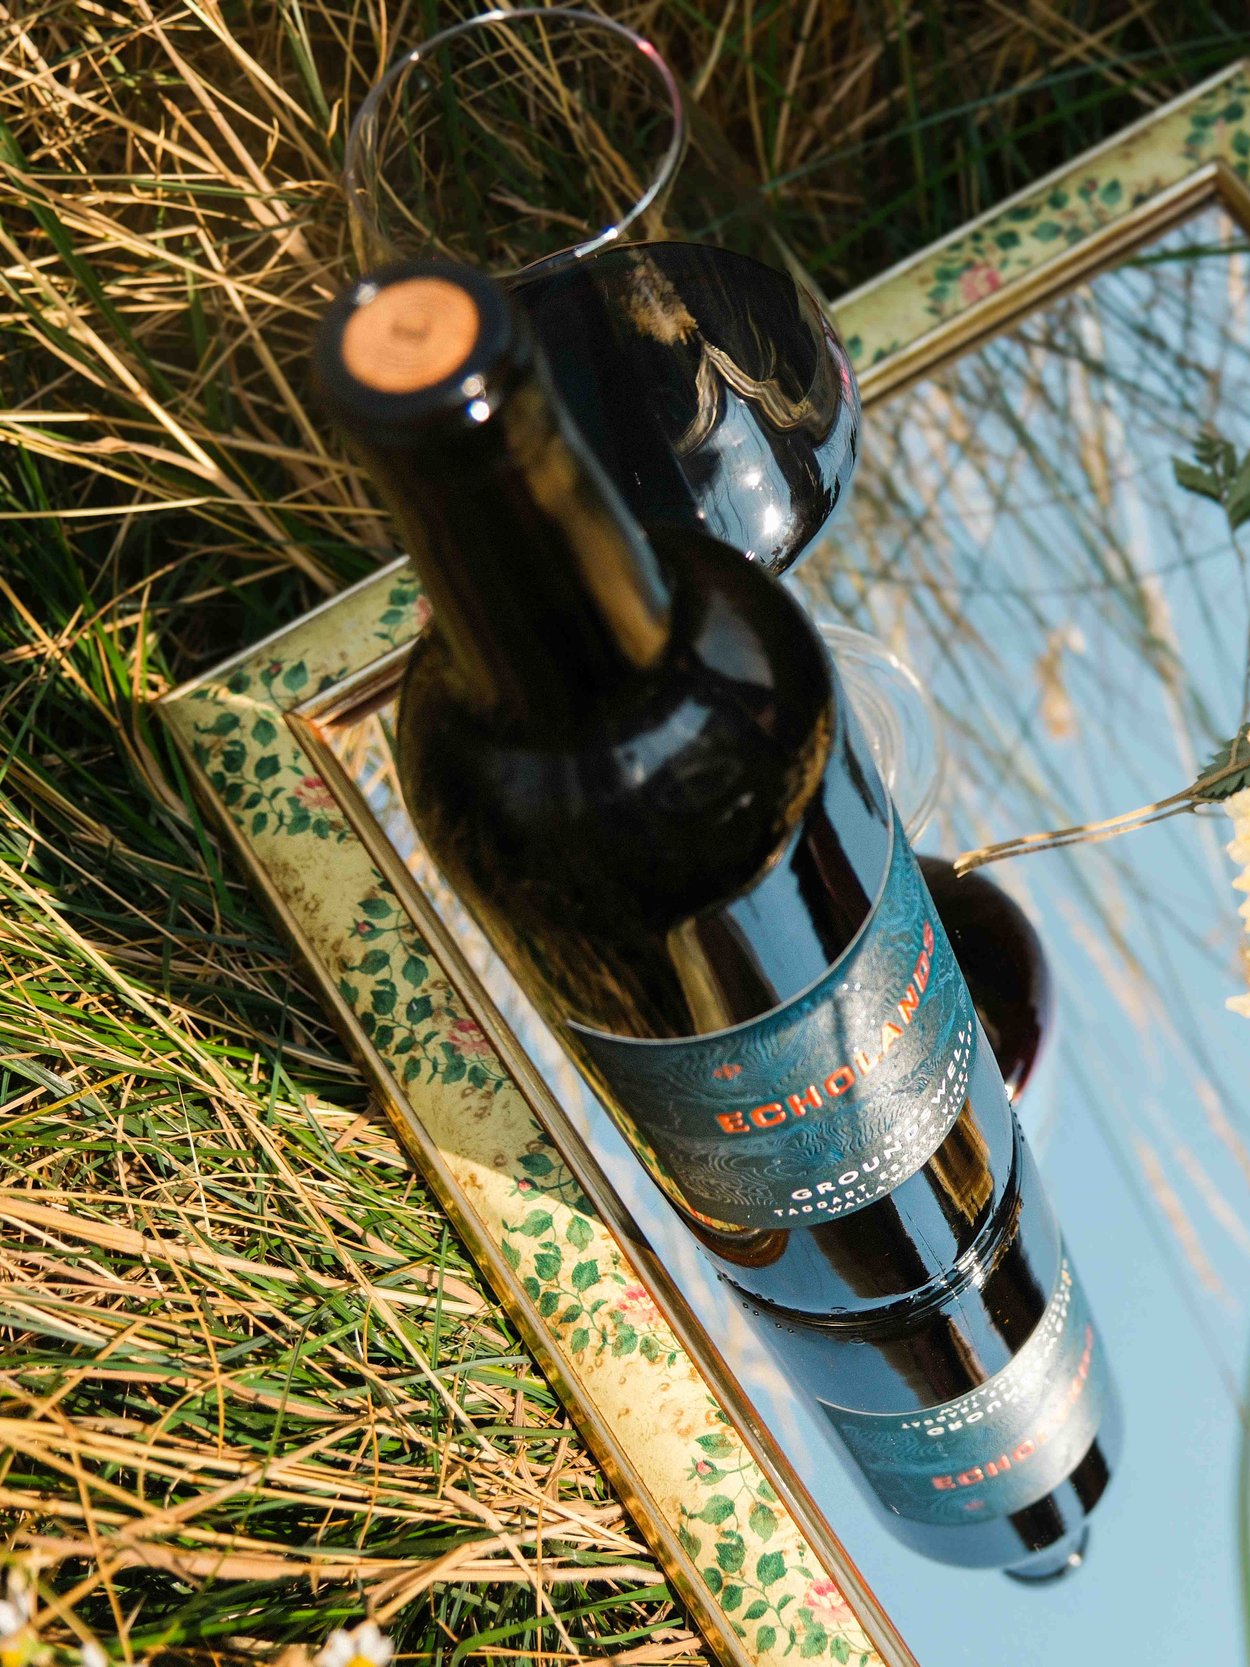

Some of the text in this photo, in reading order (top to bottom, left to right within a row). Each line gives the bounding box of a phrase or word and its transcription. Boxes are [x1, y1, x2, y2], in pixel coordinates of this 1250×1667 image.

[716, 919, 935, 1134] ECHOLANDS
[773, 1183, 867, 1217] TAGGART
[826, 1185, 886, 1215] WALLA
